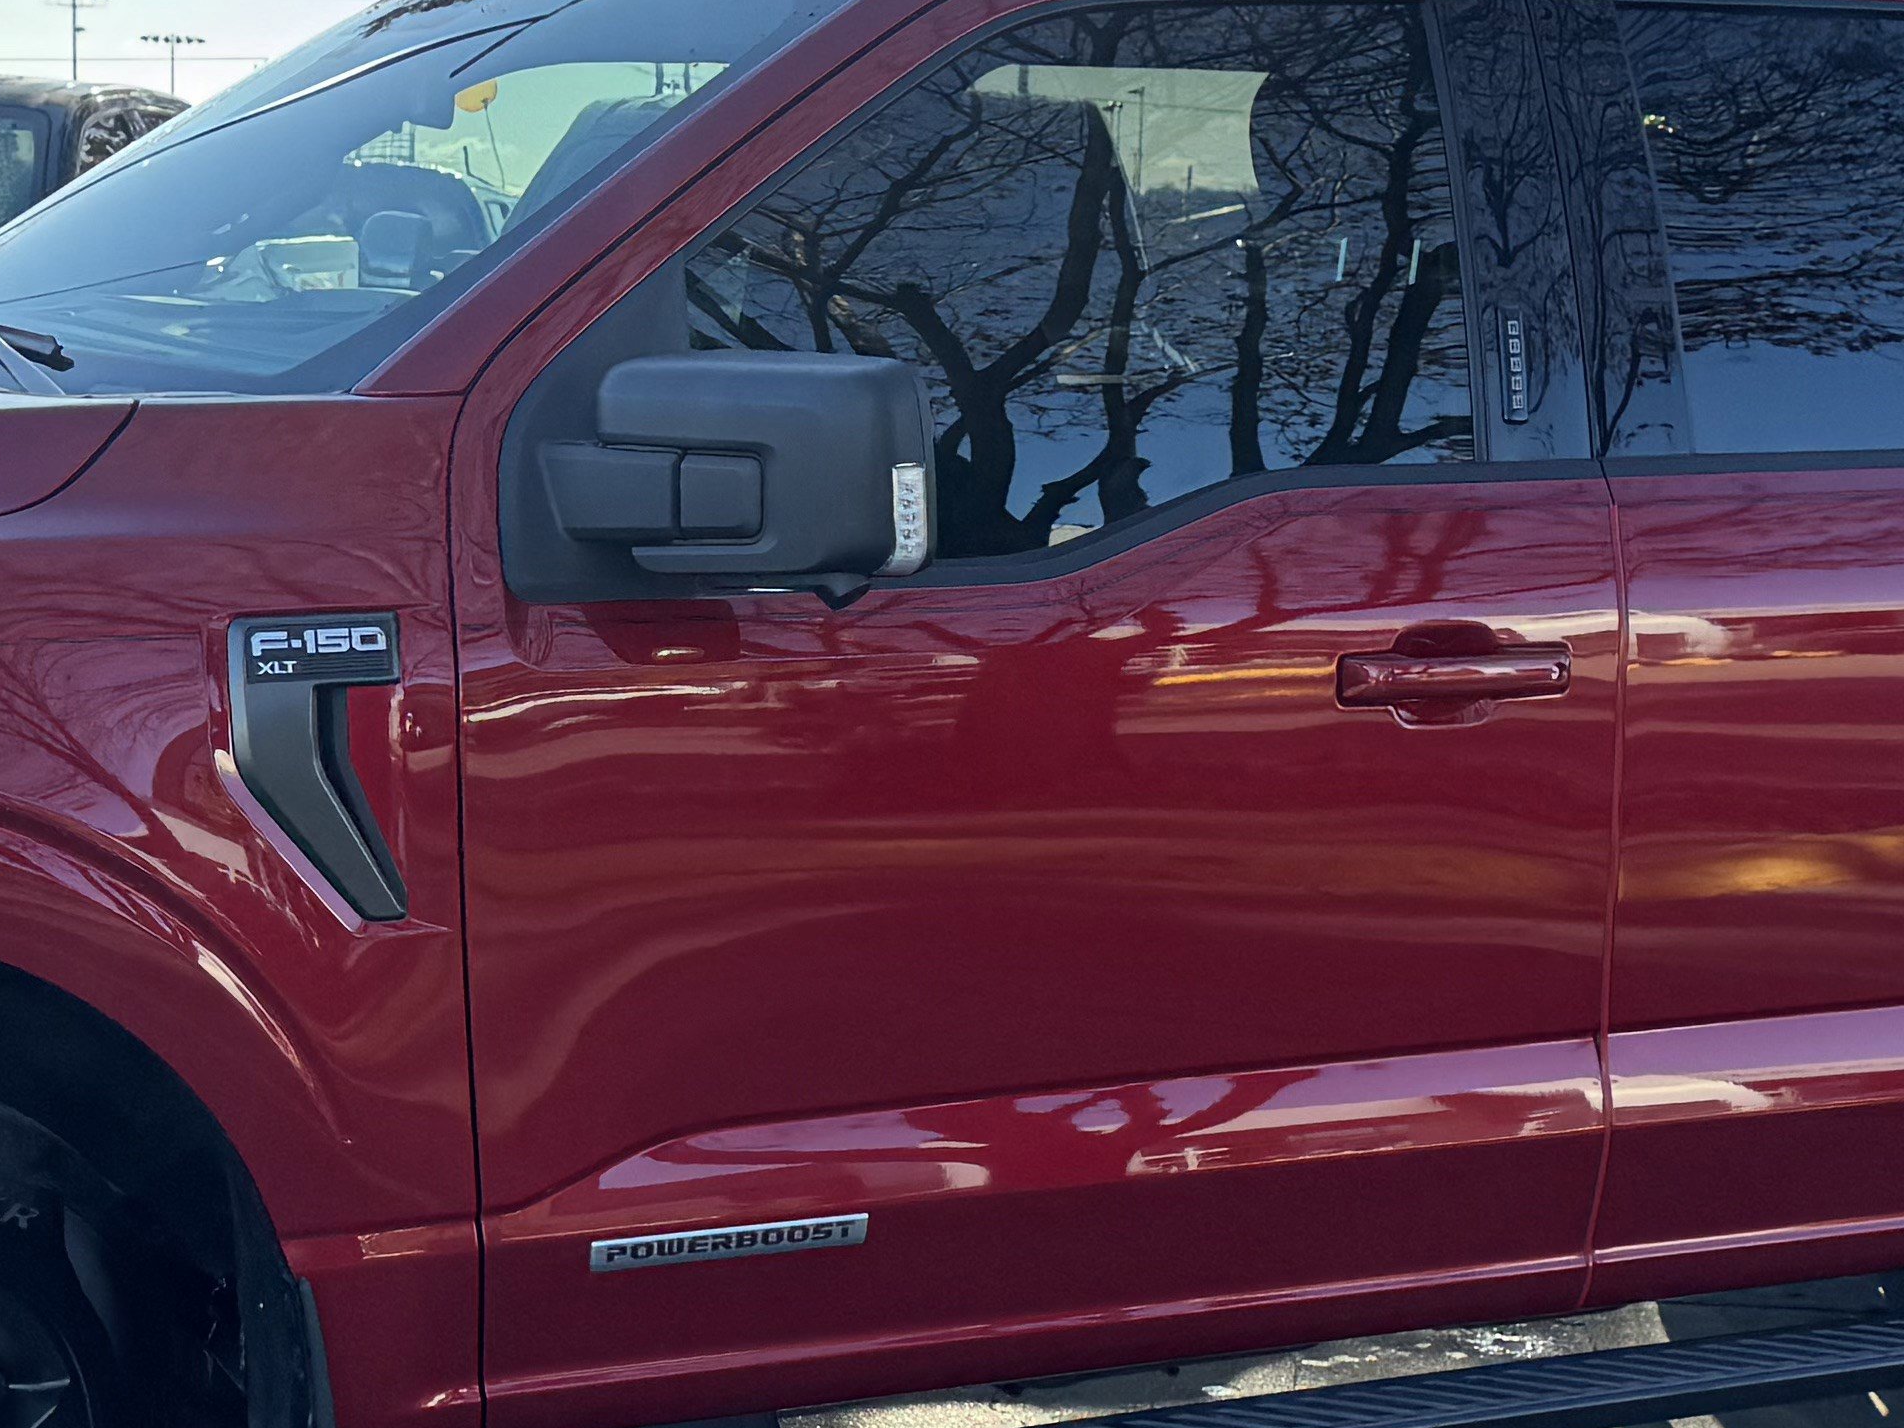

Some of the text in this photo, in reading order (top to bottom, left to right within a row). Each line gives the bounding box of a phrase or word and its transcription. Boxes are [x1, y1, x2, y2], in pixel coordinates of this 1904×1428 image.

[250, 626, 387, 657] F-150
[257, 660, 297, 675] XLT
[606, 1220, 856, 1263] POWERBOOST
